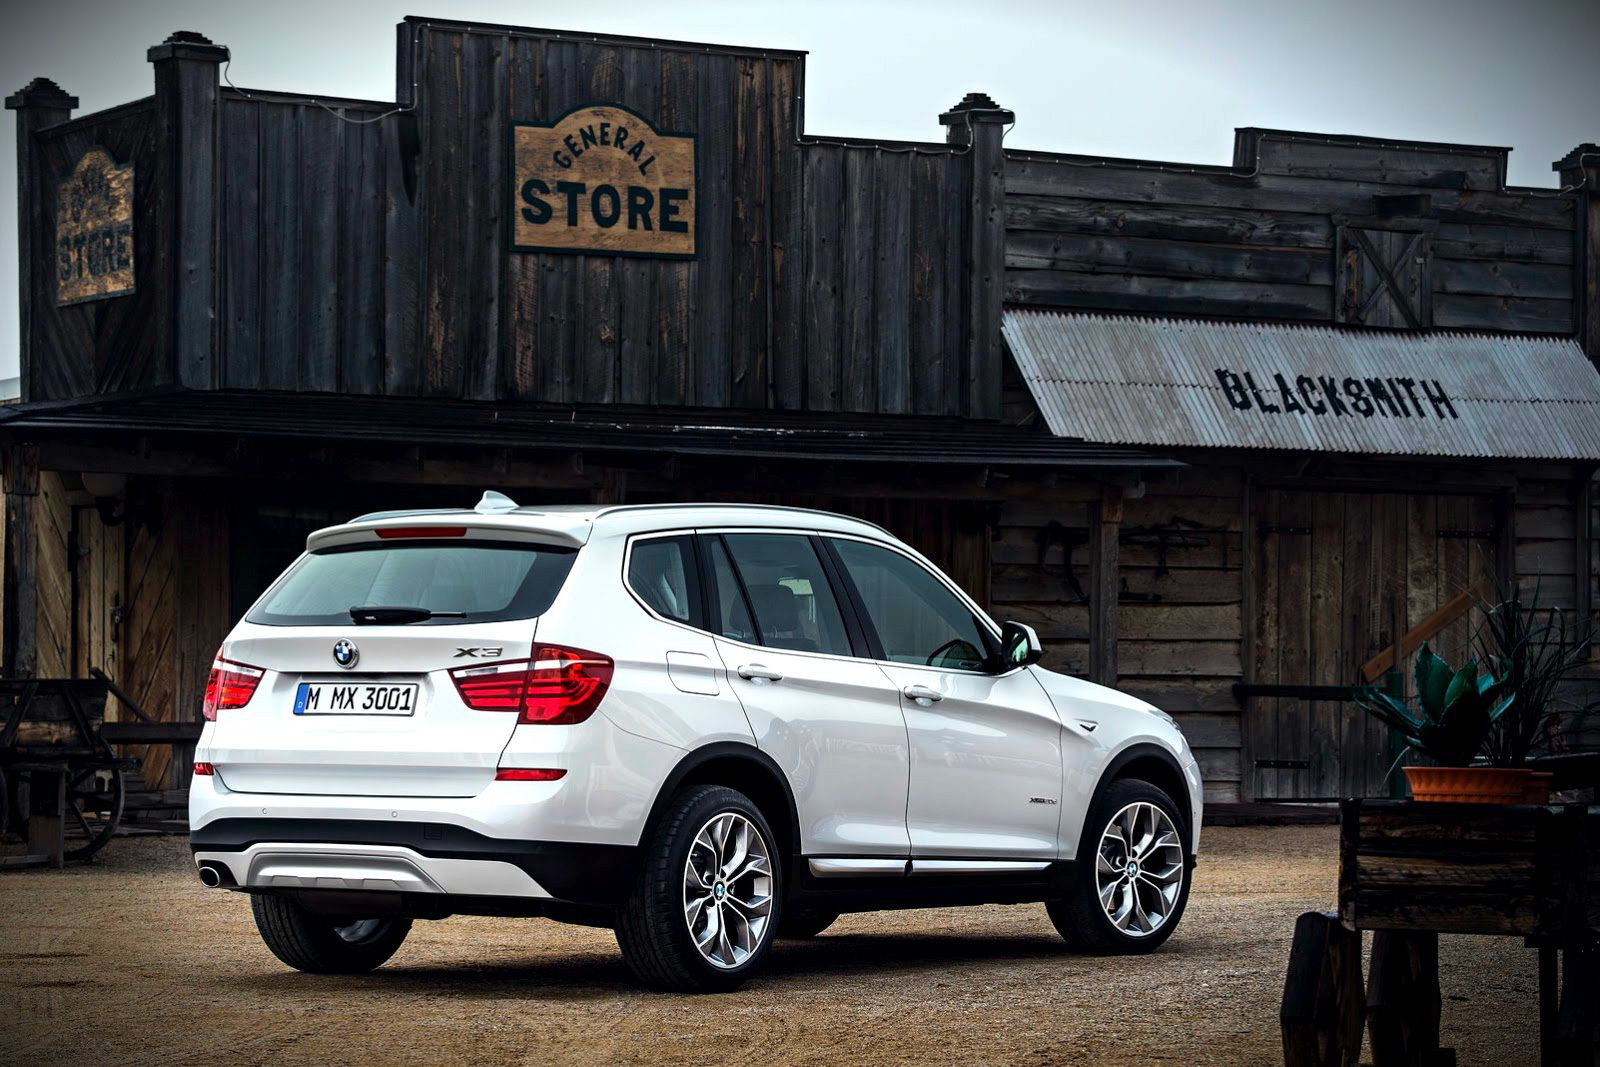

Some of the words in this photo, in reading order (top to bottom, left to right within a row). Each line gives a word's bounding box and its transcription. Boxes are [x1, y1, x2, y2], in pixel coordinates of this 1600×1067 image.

[553, 122, 655, 176] GENERAL
[521, 179, 688, 233] STORE
[1214, 368, 1458, 419] BLACKSMITH
[453, 647, 503, 658] X3
[305, 687, 321, 710] M
[330, 687, 358, 710] MX
[362, 687, 411, 711] 3001
